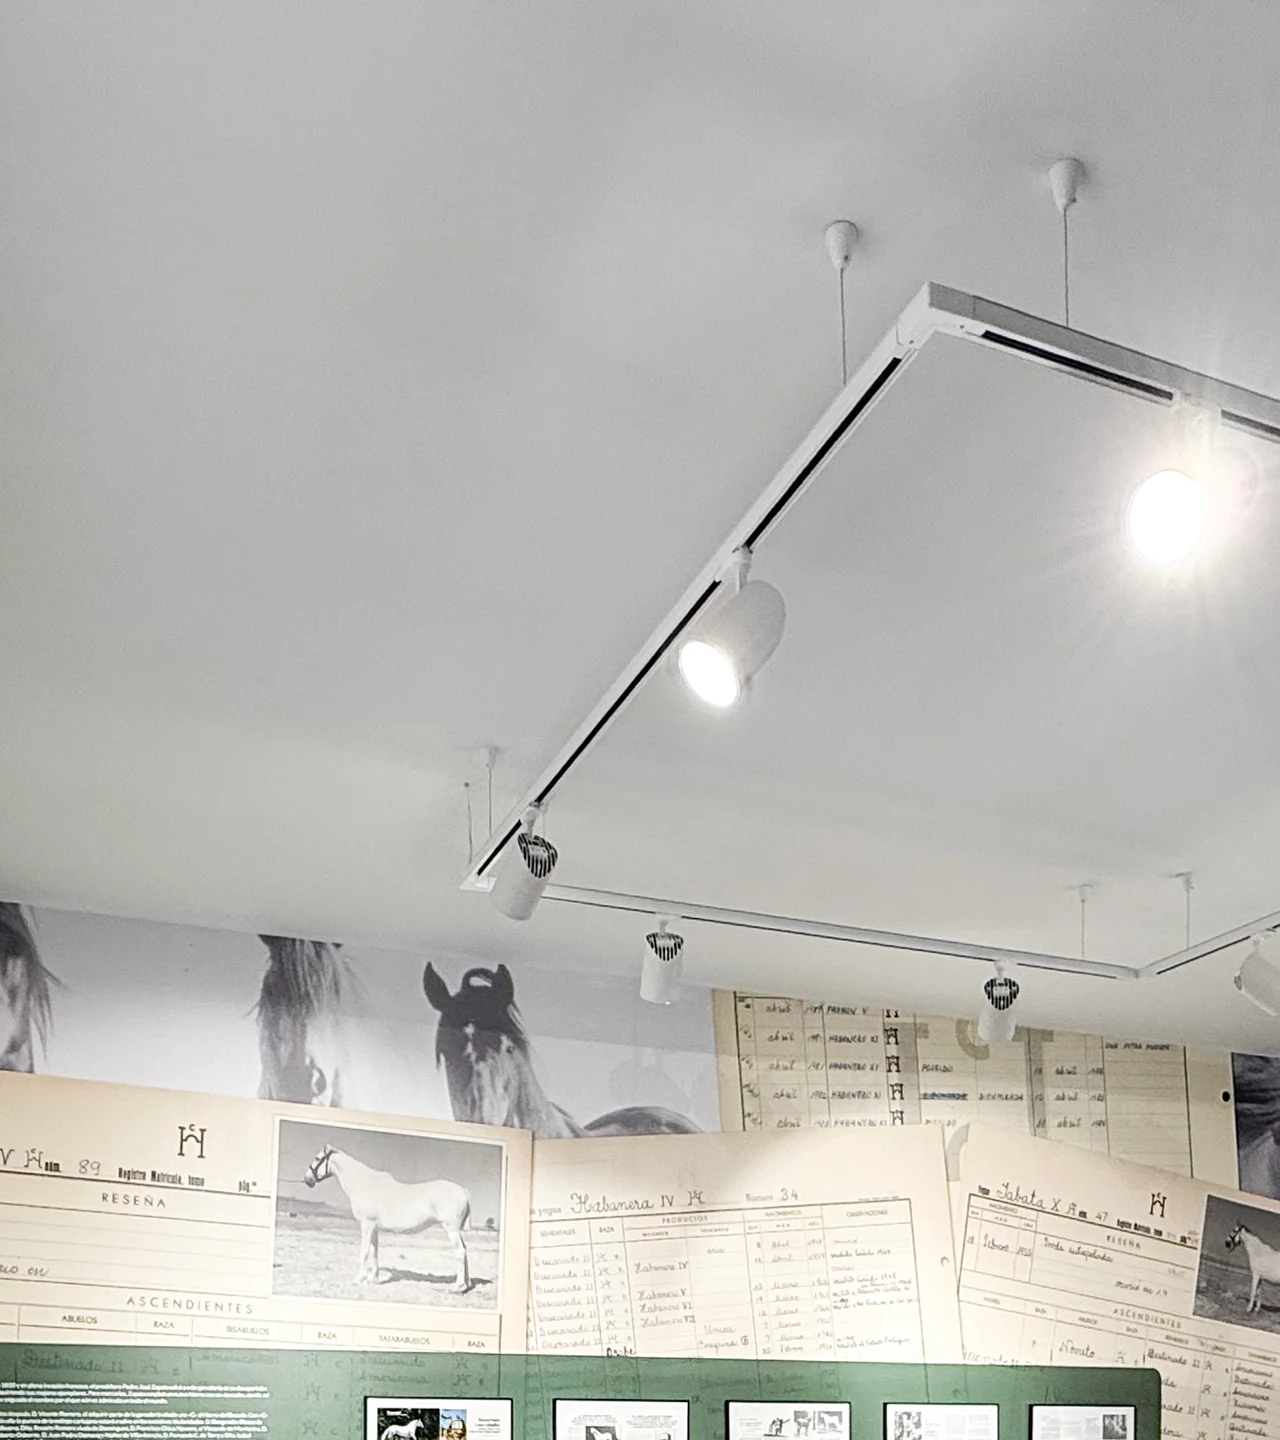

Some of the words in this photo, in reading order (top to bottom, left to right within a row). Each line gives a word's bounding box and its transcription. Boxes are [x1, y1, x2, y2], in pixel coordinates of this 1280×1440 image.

[79, 1159, 101, 1176] 89
[102, 1191, 166, 1208] RESEÑA
[781, 1188, 798, 1202] 34
[127, 1297, 254, 1315] ASCENDIENTES
[61, 1315, 98, 1324] ABUELOS
